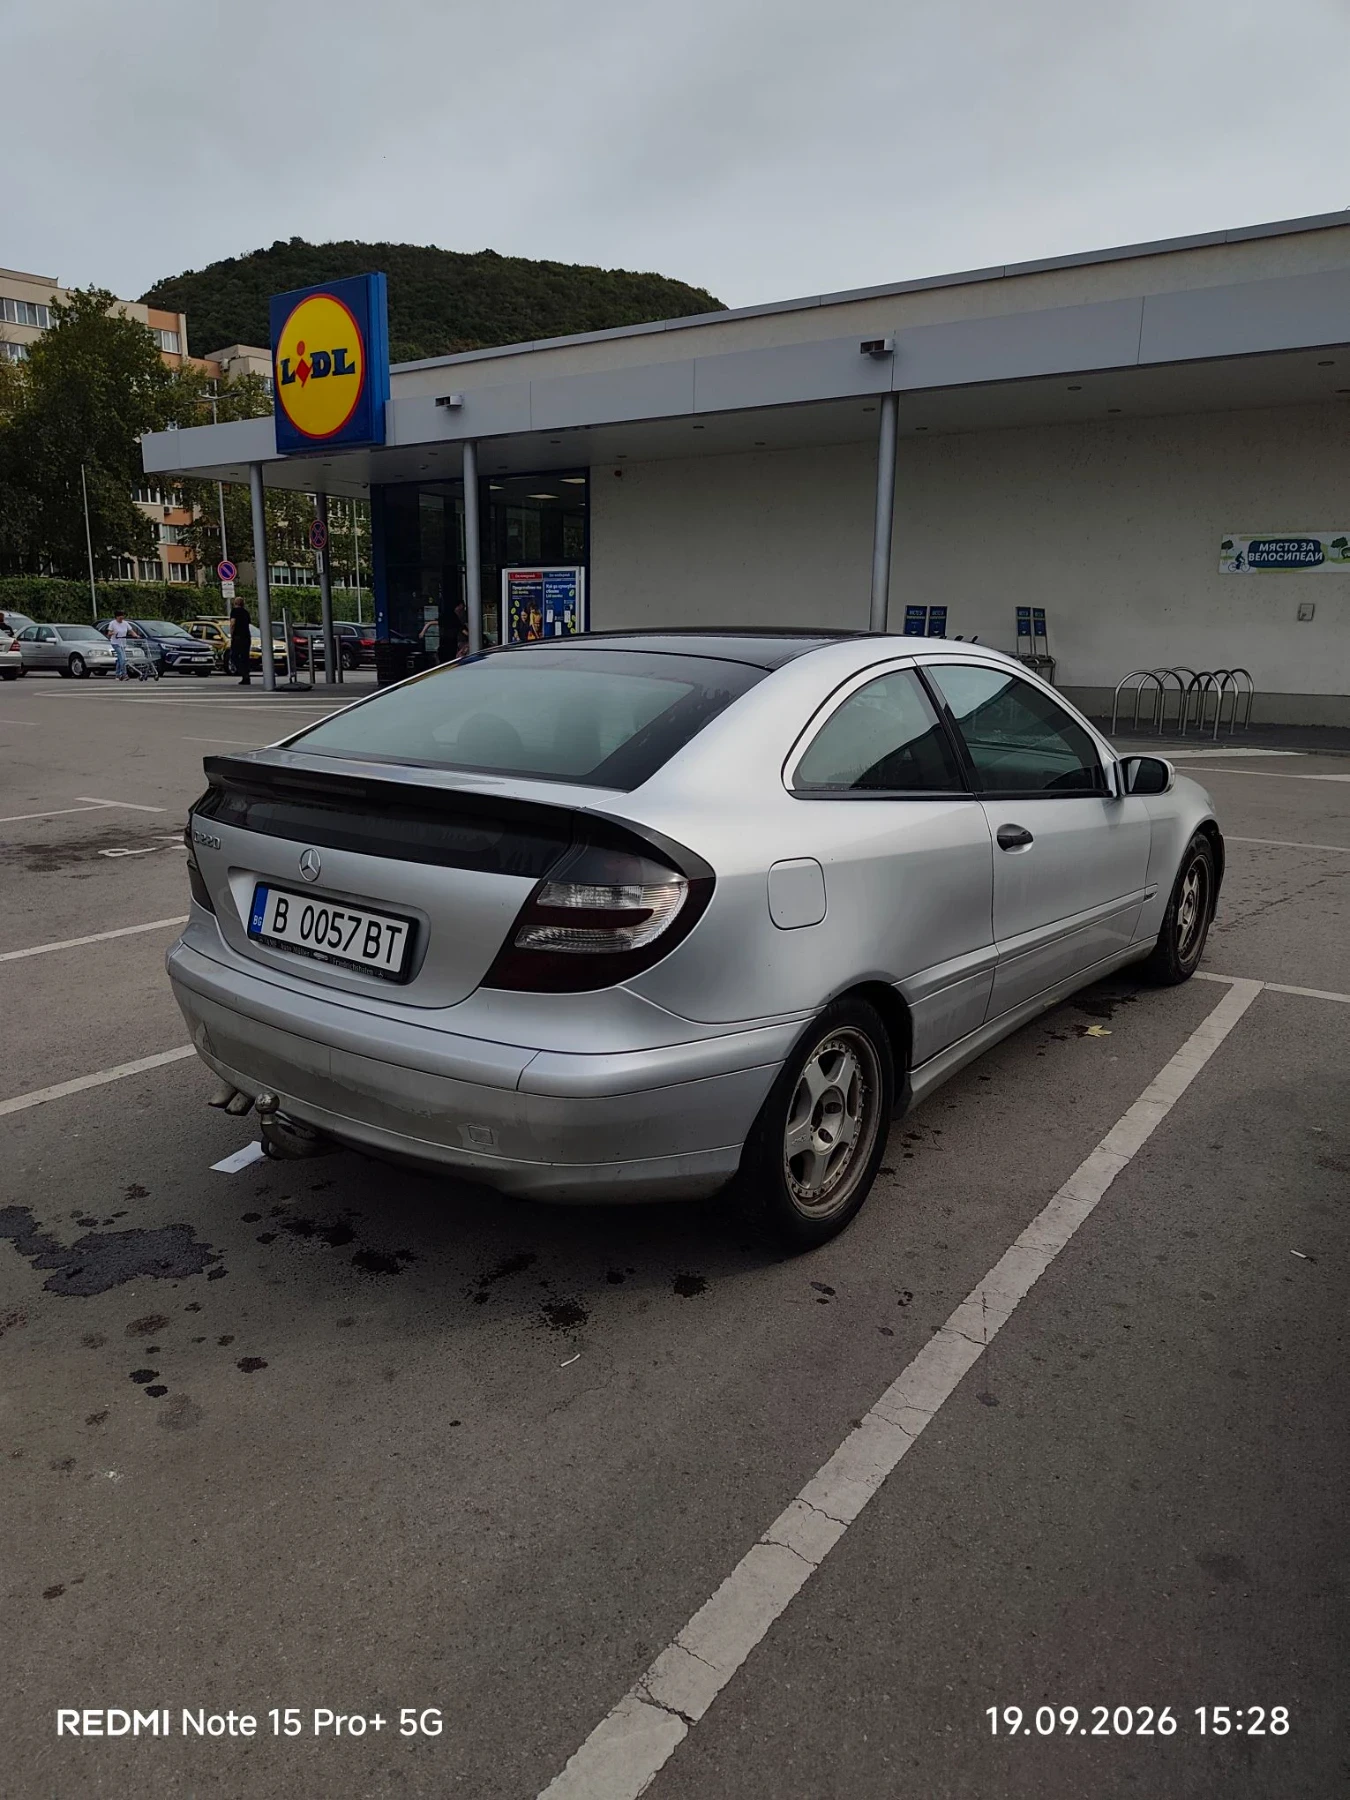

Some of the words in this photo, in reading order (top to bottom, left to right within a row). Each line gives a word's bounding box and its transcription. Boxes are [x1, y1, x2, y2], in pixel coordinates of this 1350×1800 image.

[1260, 542, 1298, 551] МЯСТО
[1300, 542, 1314, 551] ЗА
[1248, 552, 1323, 562] ВЕЛОСИПЕДИ
[252, 914, 263, 926] BG
[272, 897, 289, 934] B
[300, 905, 362, 952] 0057
[362, 920, 403, 964] BT
